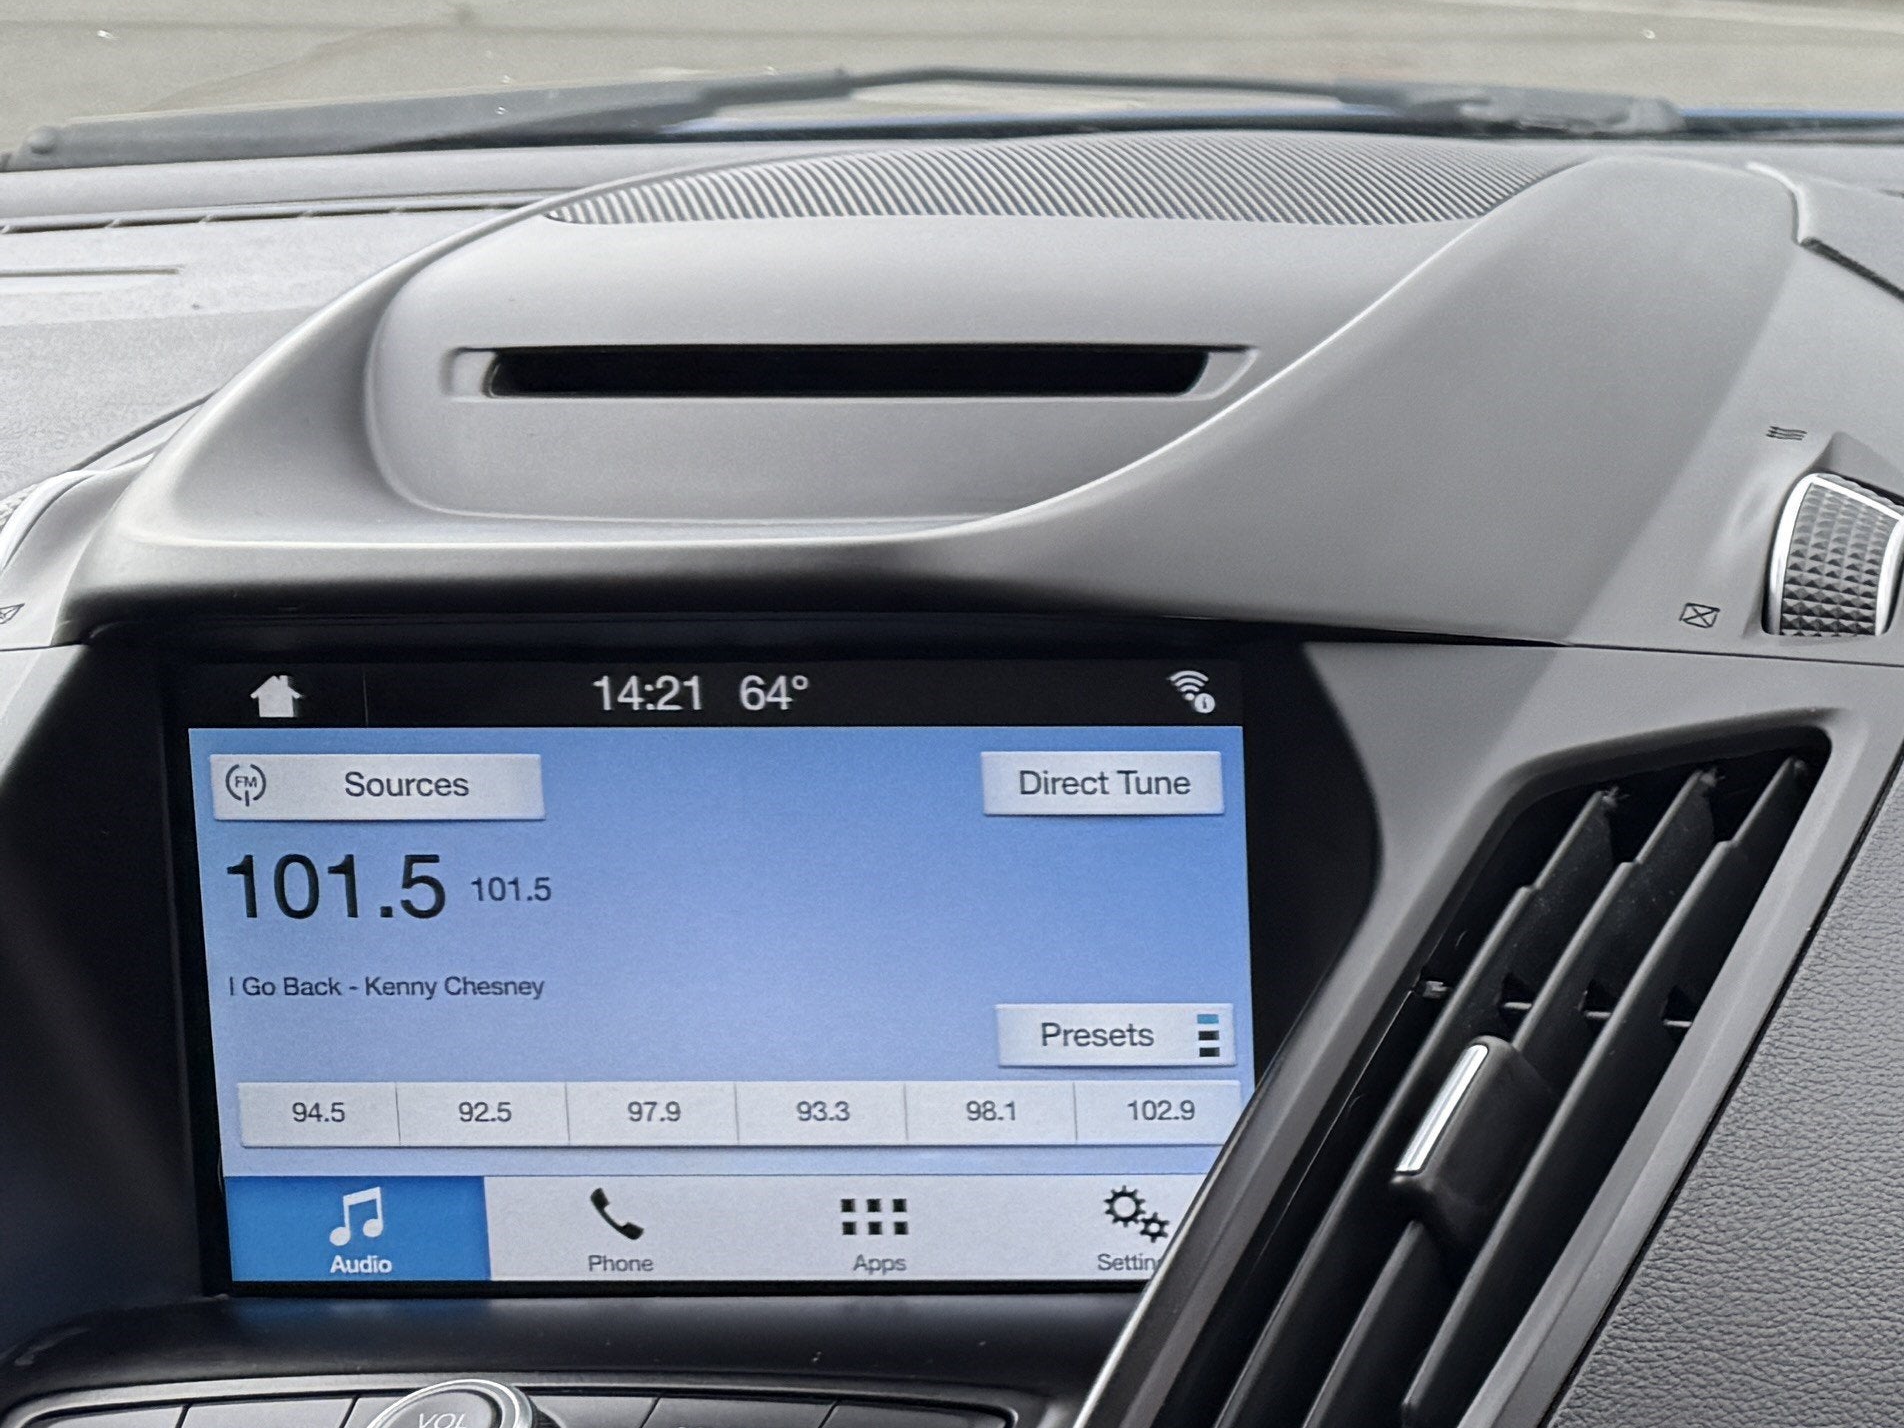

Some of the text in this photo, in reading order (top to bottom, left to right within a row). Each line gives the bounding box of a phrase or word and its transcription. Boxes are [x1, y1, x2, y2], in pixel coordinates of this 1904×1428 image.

[593, 675, 702, 711] 14:21
[740, 675, 808, 711] 64°
[234, 776, 258, 788] FM
[344, 771, 470, 797] Sources
[1018, 769, 1191, 797] Direct Tune
[226, 853, 446, 919] 101.5
[471, 877, 552, 902] 101.5
[242, 977, 276, 997] Go
[284, 977, 341, 997] Back
[364, 977, 437, 1000] Kenny
[444, 976, 545, 1000] Chesney
[1040, 1022, 1155, 1049] Presets
[291, 1100, 346, 1125] 94.5
[458, 1100, 513, 1125] 92.5
[627, 1099, 682, 1125] 97.9
[796, 1099, 852, 1125] 93.3
[965, 1099, 1018, 1124] 98.1
[1126, 1099, 1197, 1124] 102.9
[330, 1254, 393, 1276] Audio
[587, 1254, 655, 1274] Phone
[852, 1254, 907, 1278] Apps
